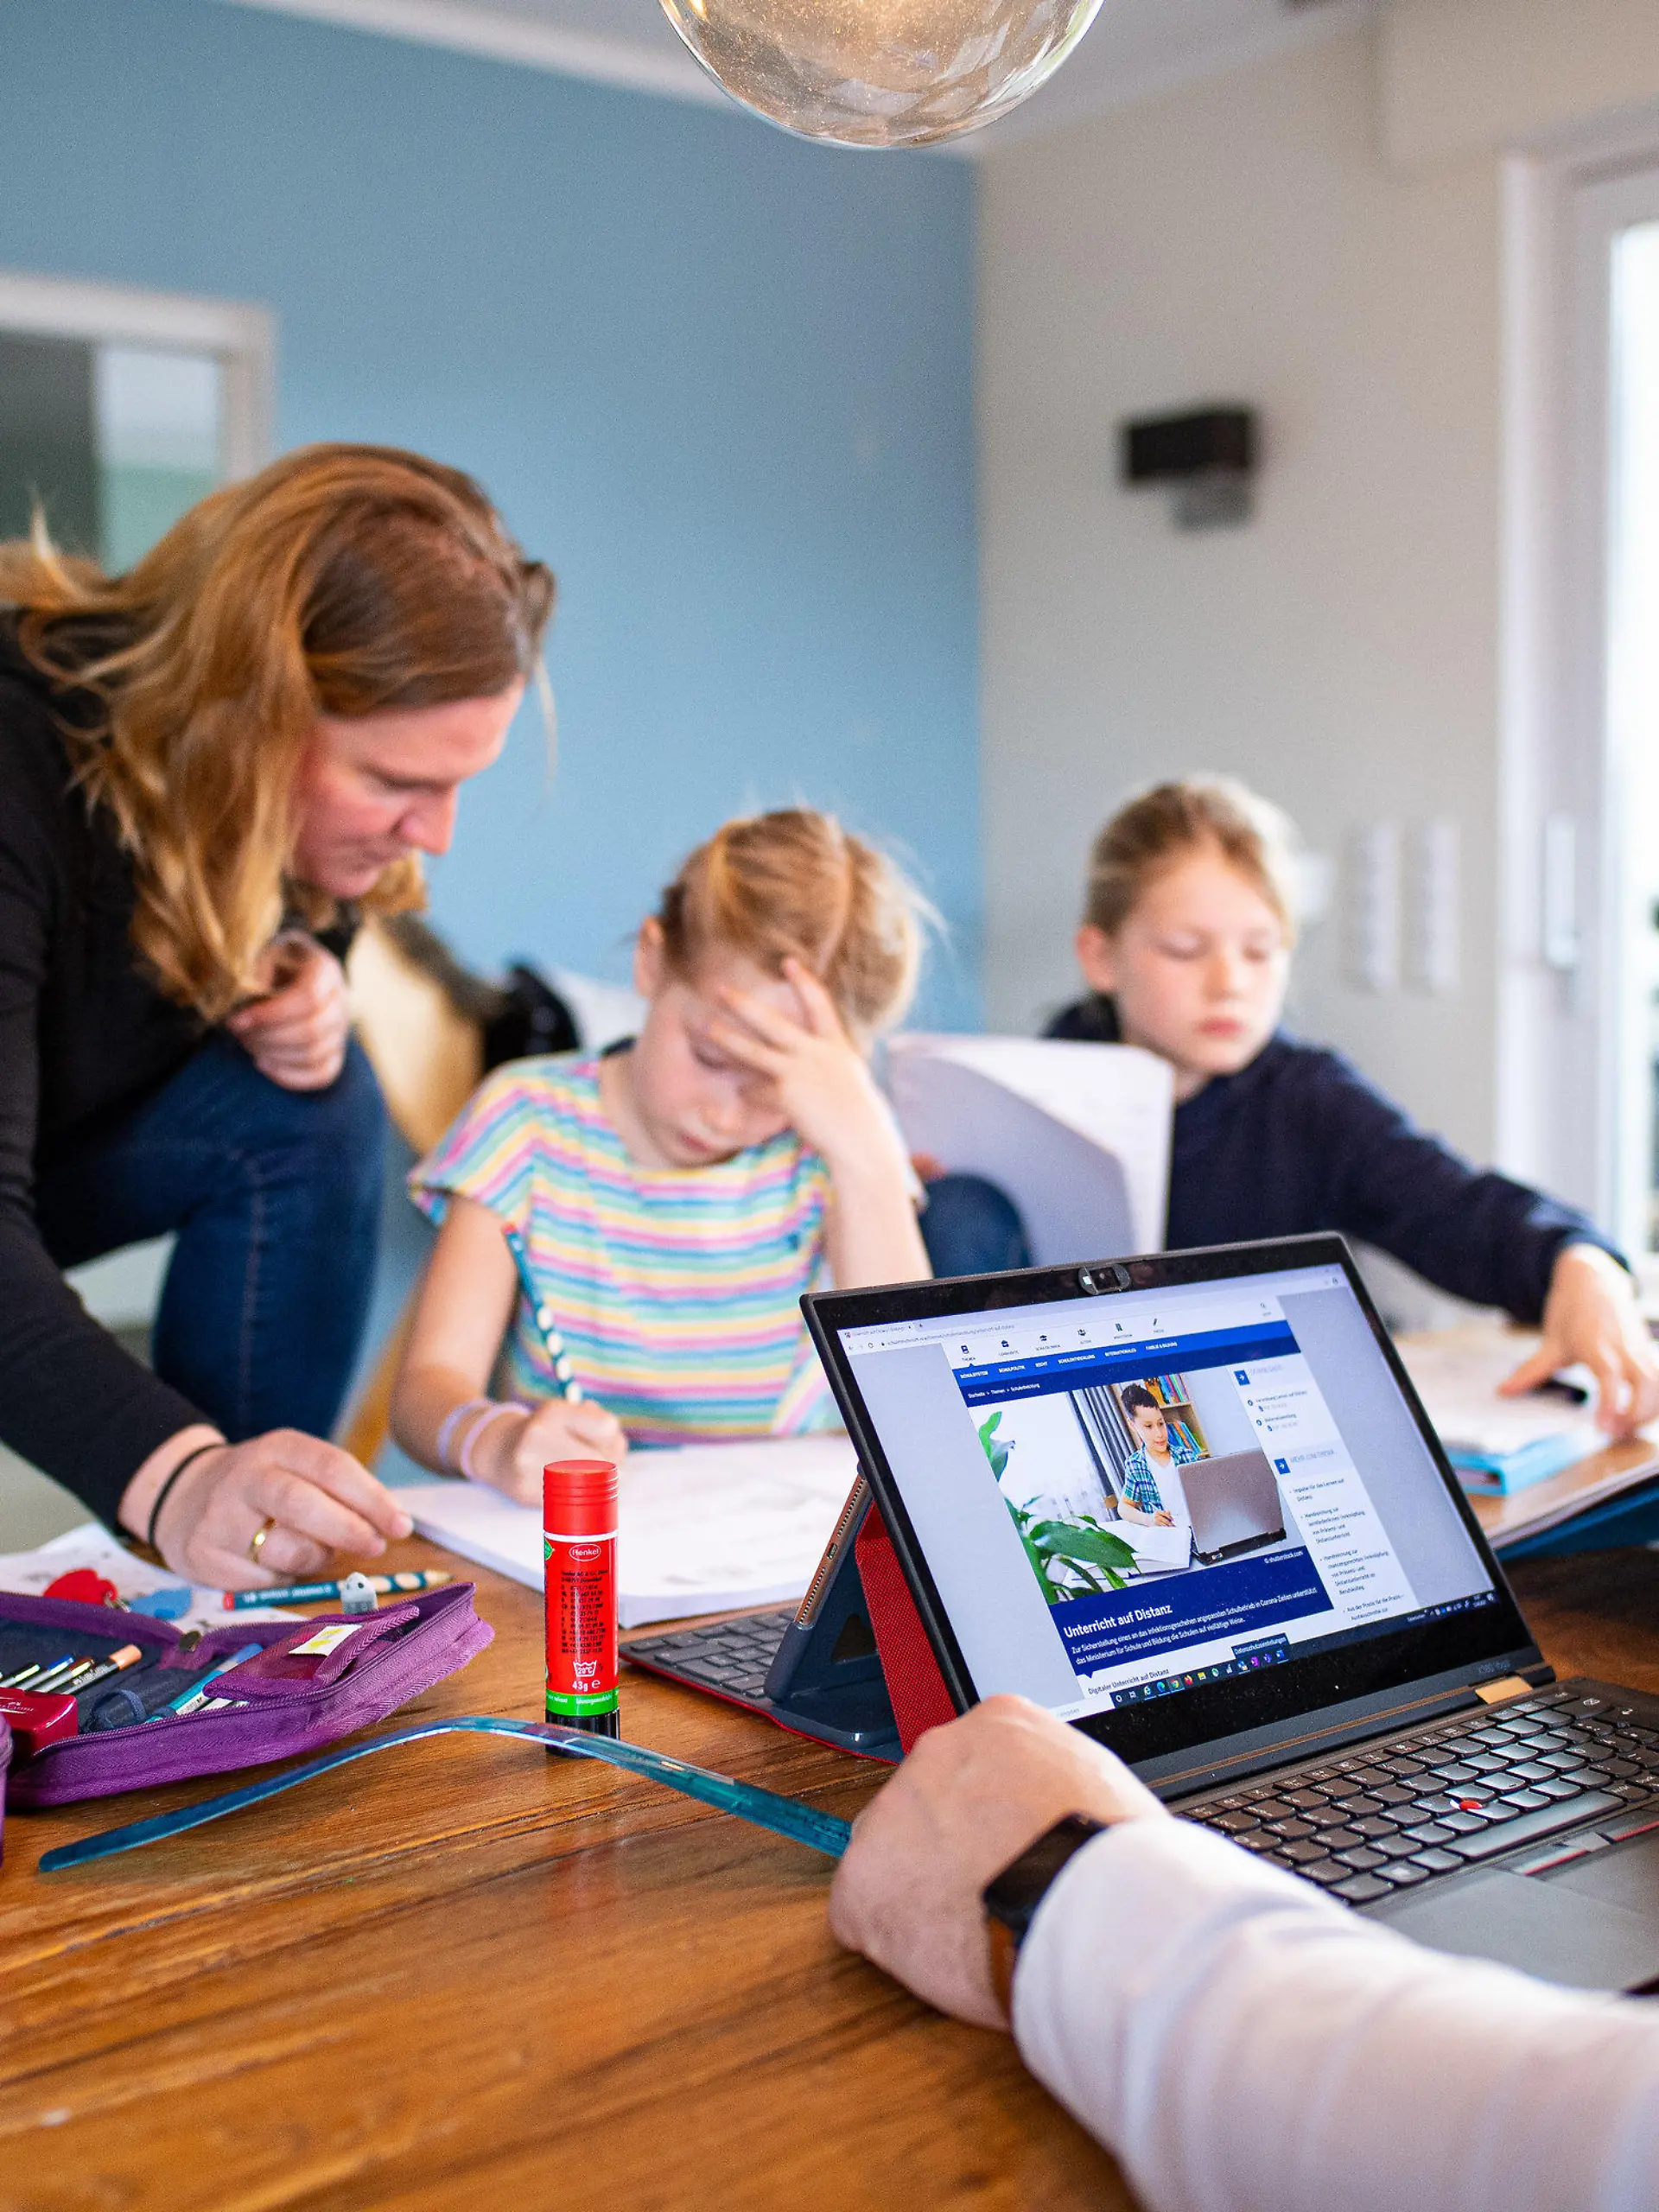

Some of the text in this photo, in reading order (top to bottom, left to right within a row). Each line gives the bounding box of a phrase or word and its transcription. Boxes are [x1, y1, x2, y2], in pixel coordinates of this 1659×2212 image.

[572, 1548, 599, 1557] Henkel
[1269, 1551, 1303, 1562] shutterstock.com
[1064, 1605, 1172, 1637] Unterricht auf Distanz
[1081, 1638, 1118, 1651] Sicherstellung
[1226, 1603, 1255, 1615] Schulbetrieb
[1085, 1650, 1116, 1662] Ministerium
[1151, 1636, 1172, 1644] Bildung
[1178, 1629, 1198, 1638] Schulen
[572, 1681, 588, 1692] 43g
[1088, 1684, 1111, 1694] Digitaler
[1111, 1676, 1139, 1688] Unterricht
[1148, 1669, 1169, 1678] Distanz
